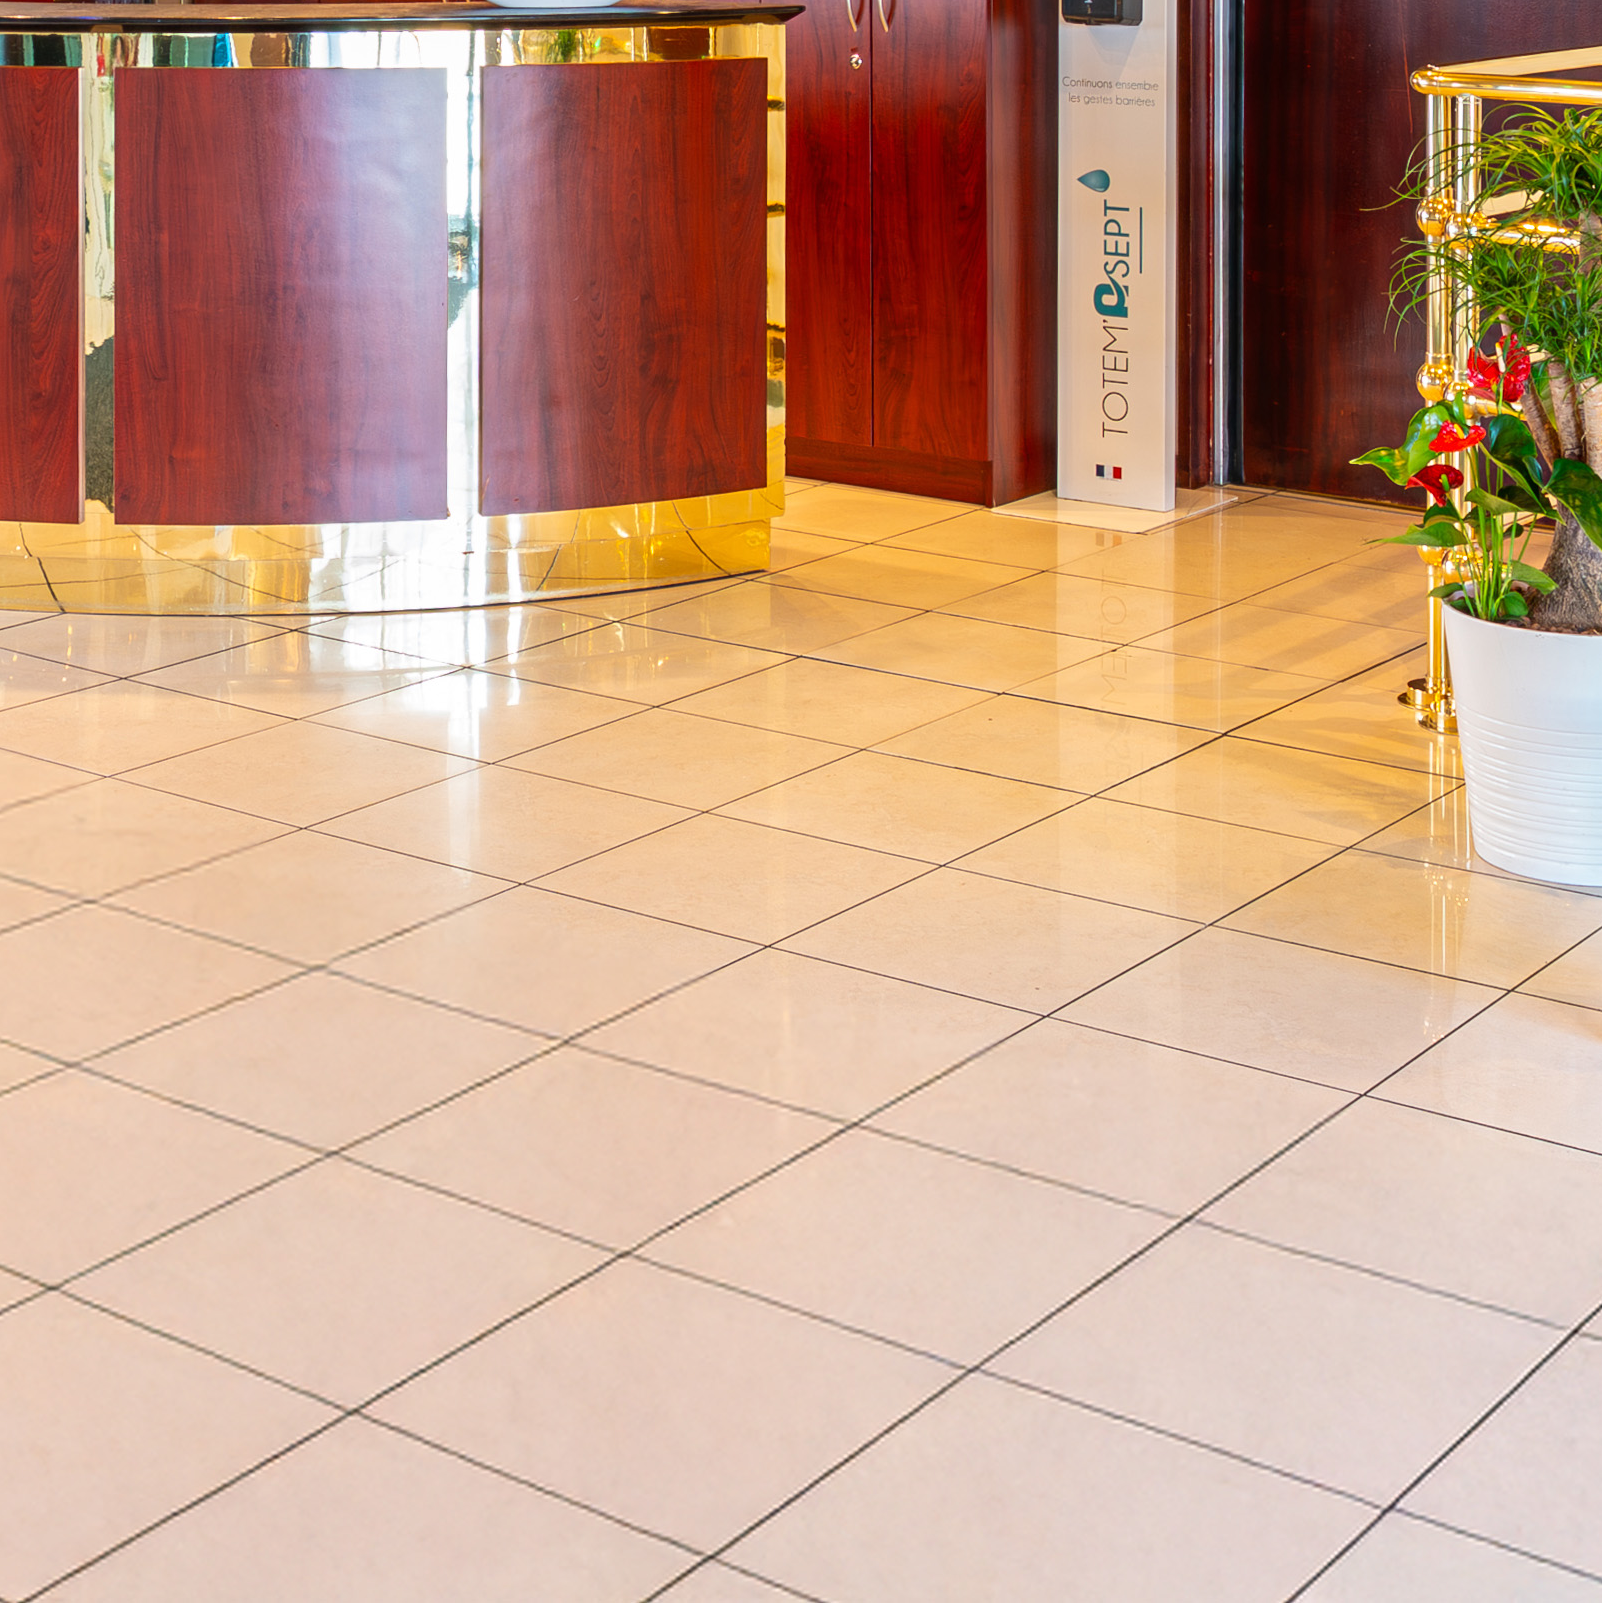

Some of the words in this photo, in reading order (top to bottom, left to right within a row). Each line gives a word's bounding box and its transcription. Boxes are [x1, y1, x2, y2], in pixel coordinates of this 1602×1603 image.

[1062, 76, 1112, 89] Continuons
[1115, 79, 1159, 91] ensemble
[1068, 92, 1081, 103] les
[1083, 94, 1113, 105] gestes
[1115, 94, 1155, 107] barrières
